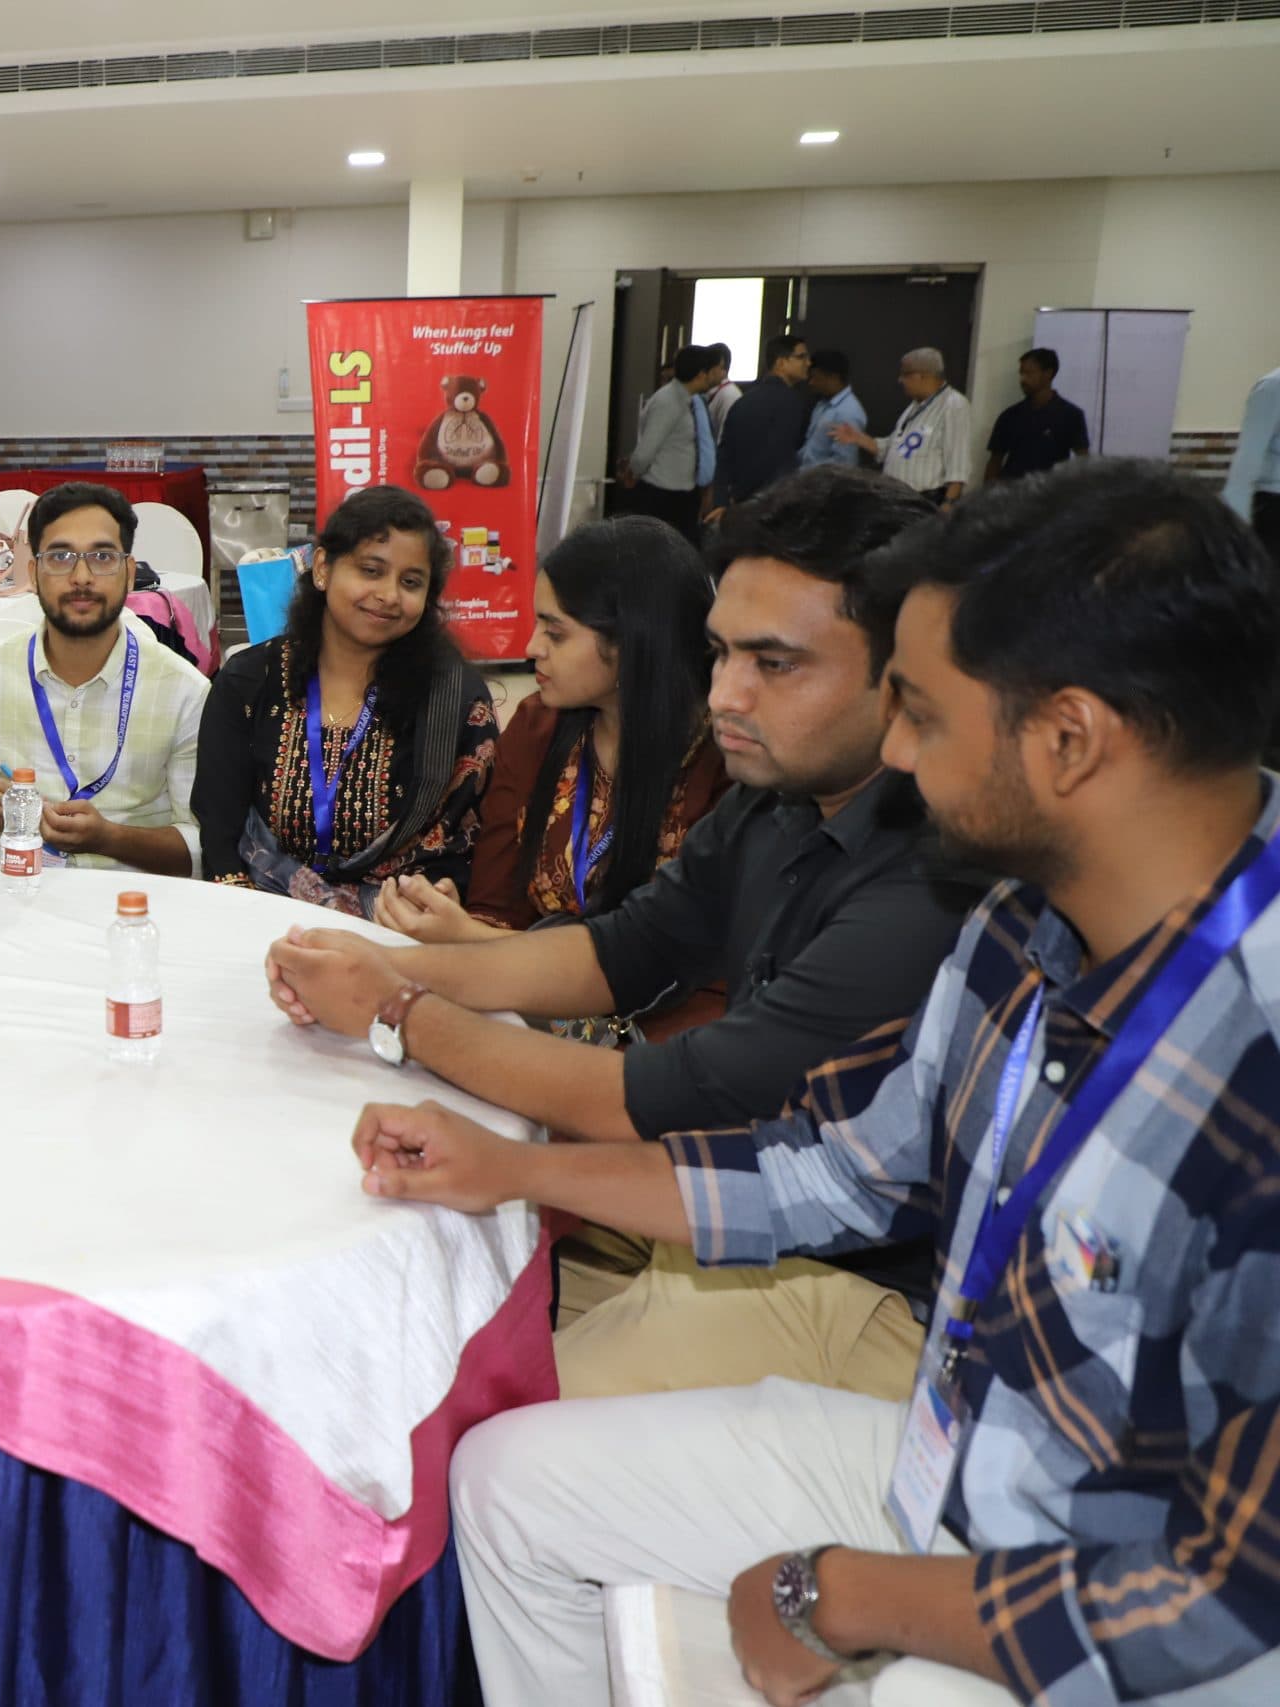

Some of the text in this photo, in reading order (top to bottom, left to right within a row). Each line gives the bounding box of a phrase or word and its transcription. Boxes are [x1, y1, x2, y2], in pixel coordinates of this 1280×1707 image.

[413, 324, 514, 340] When Lungs feel
[431, 343, 501, 355] 'Stuffed' Up
[127, 648, 137, 668] EAST
[125, 669, 135, 688] ZONE
